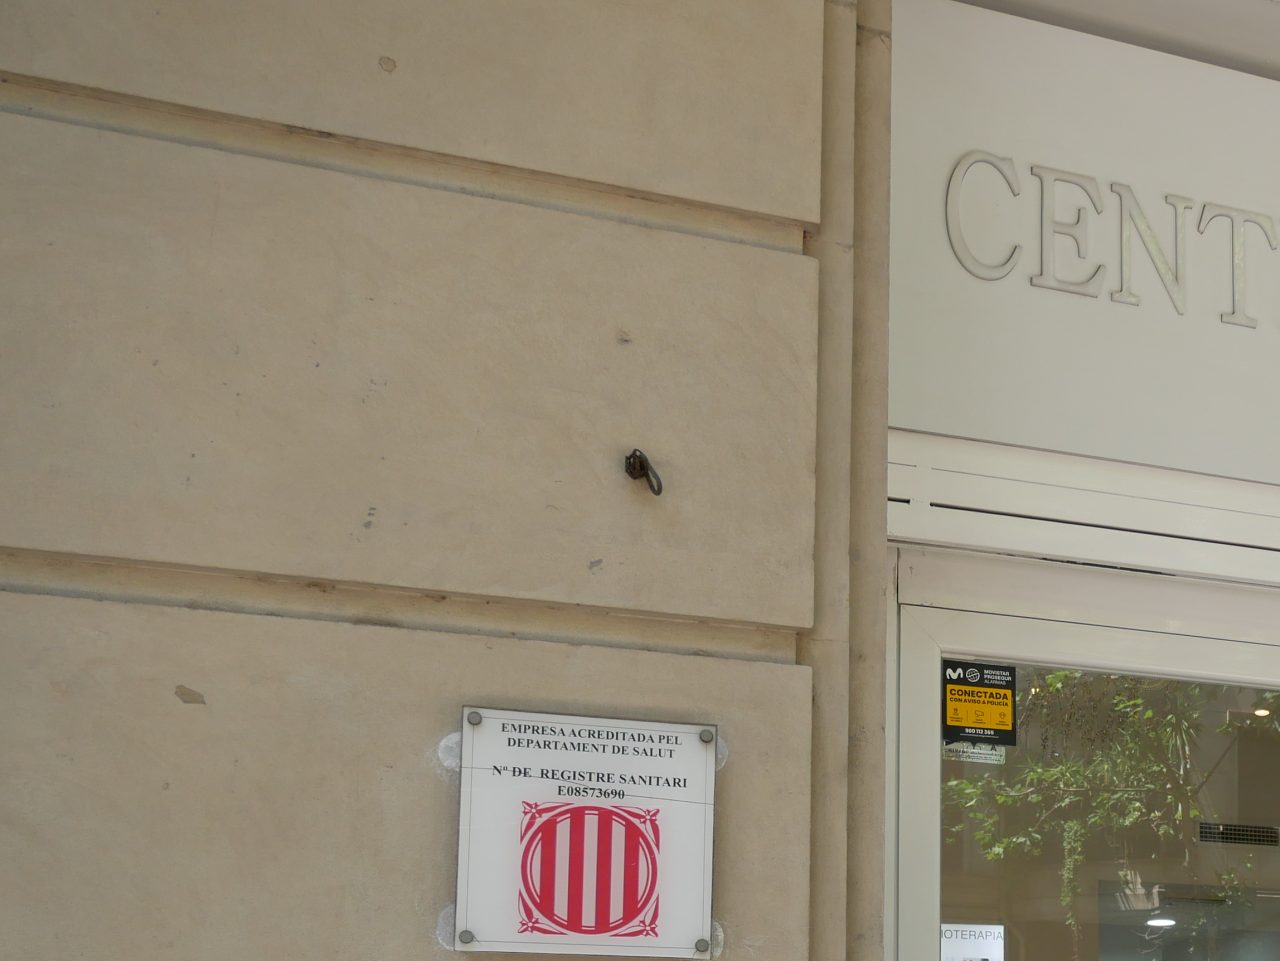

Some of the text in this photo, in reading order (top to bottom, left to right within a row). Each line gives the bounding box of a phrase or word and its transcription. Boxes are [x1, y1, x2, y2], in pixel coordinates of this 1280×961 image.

[949, 688, 1008, 701] CONECTADA
[501, 722, 683, 746] EMPRESA ACREDITADA PEL
[507, 737, 676, 759] DEPARTAMENT DE SALUT
[512, 766, 532, 778] DE
[540, 768, 616, 783] REGISTRE
[619, 774, 688, 788] SANITARI
[557, 785, 626, 800] E08573690
